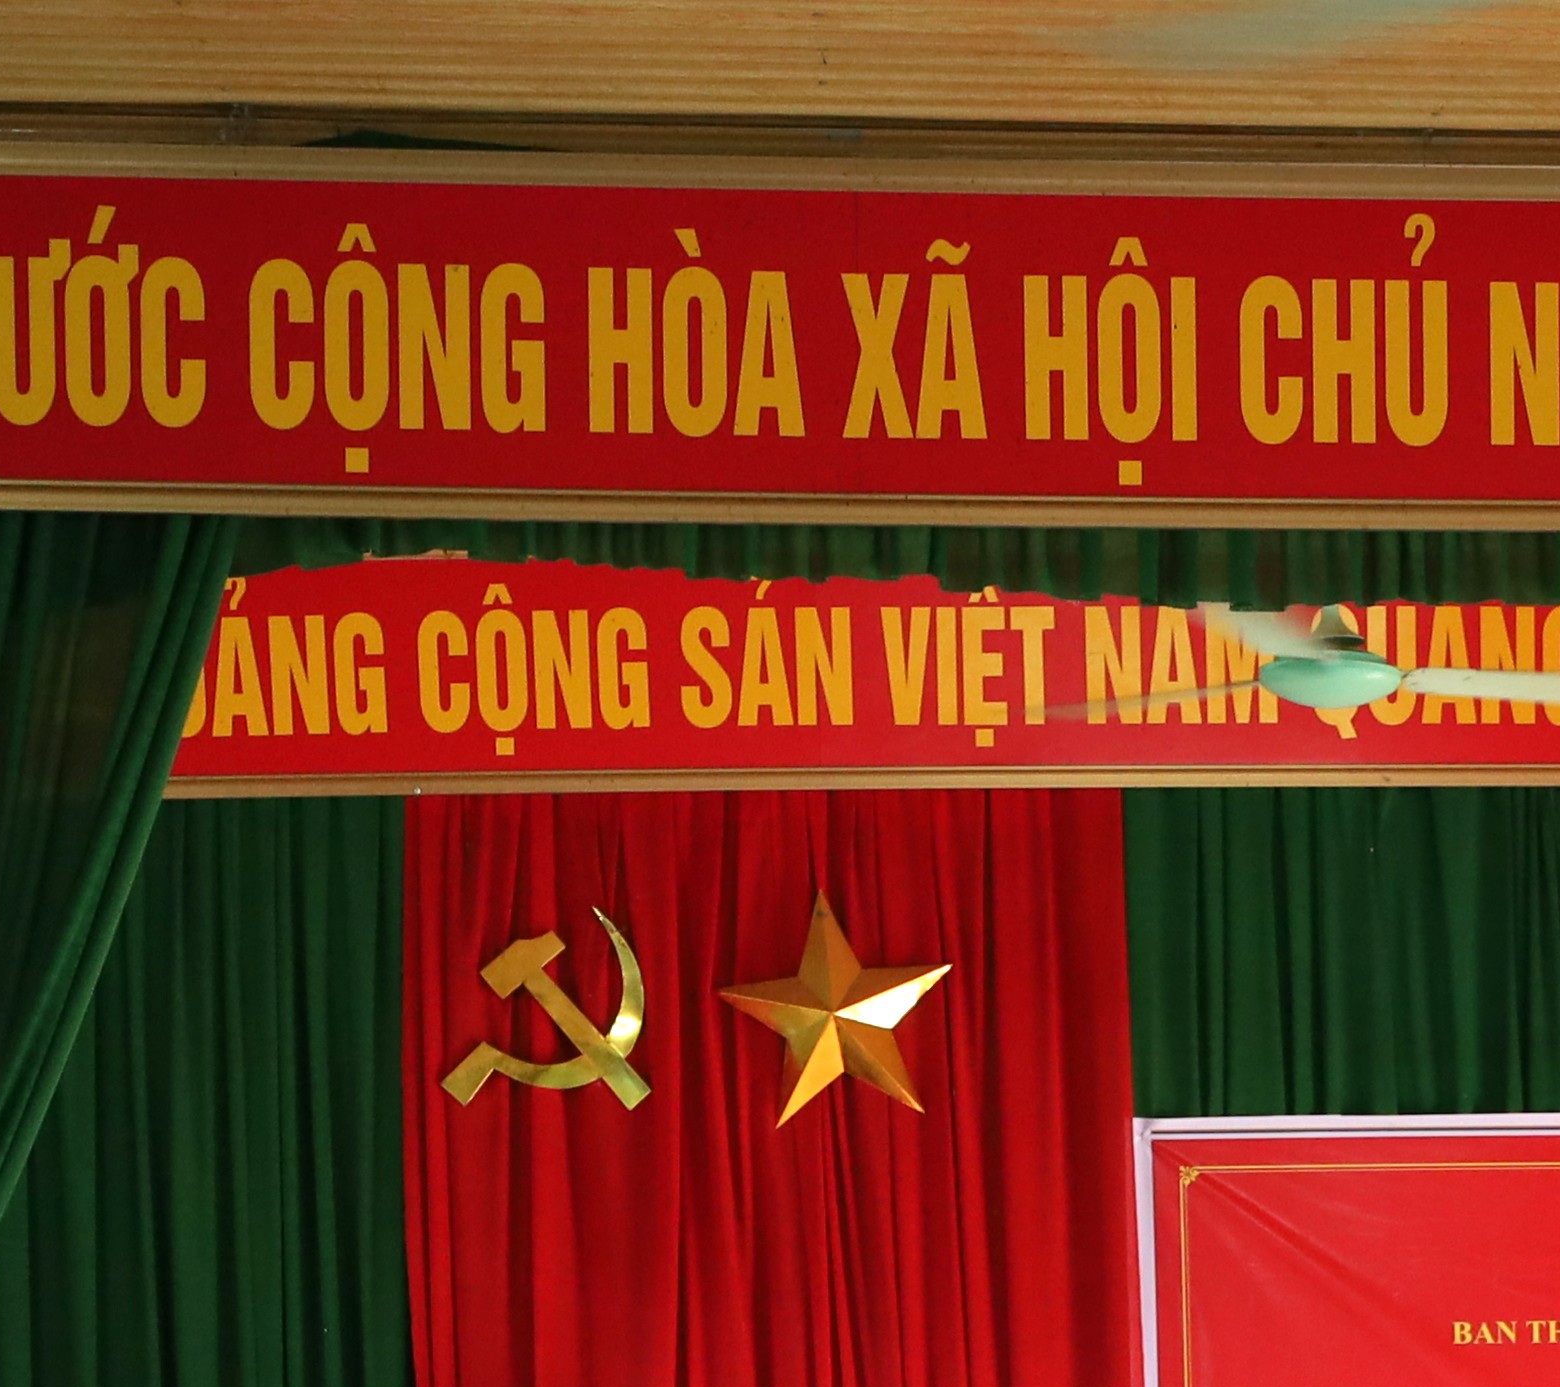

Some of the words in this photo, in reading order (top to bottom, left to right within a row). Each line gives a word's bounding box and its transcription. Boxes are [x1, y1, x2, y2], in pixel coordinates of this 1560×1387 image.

[249, 223, 547, 474] CỘNG
[589, 228, 806, 438] HÒA
[842, 238, 988, 440] XÃ
[1023, 237, 1197, 486] HỘI
[1239, 213, 1449, 447] CHỦ
[418, 583, 650, 756] CỘNG
[881, 585, 1055, 748] VIỆT
[1084, 600, 1278, 726] NAM
[1454, 1320, 1516, 1346] BAN
